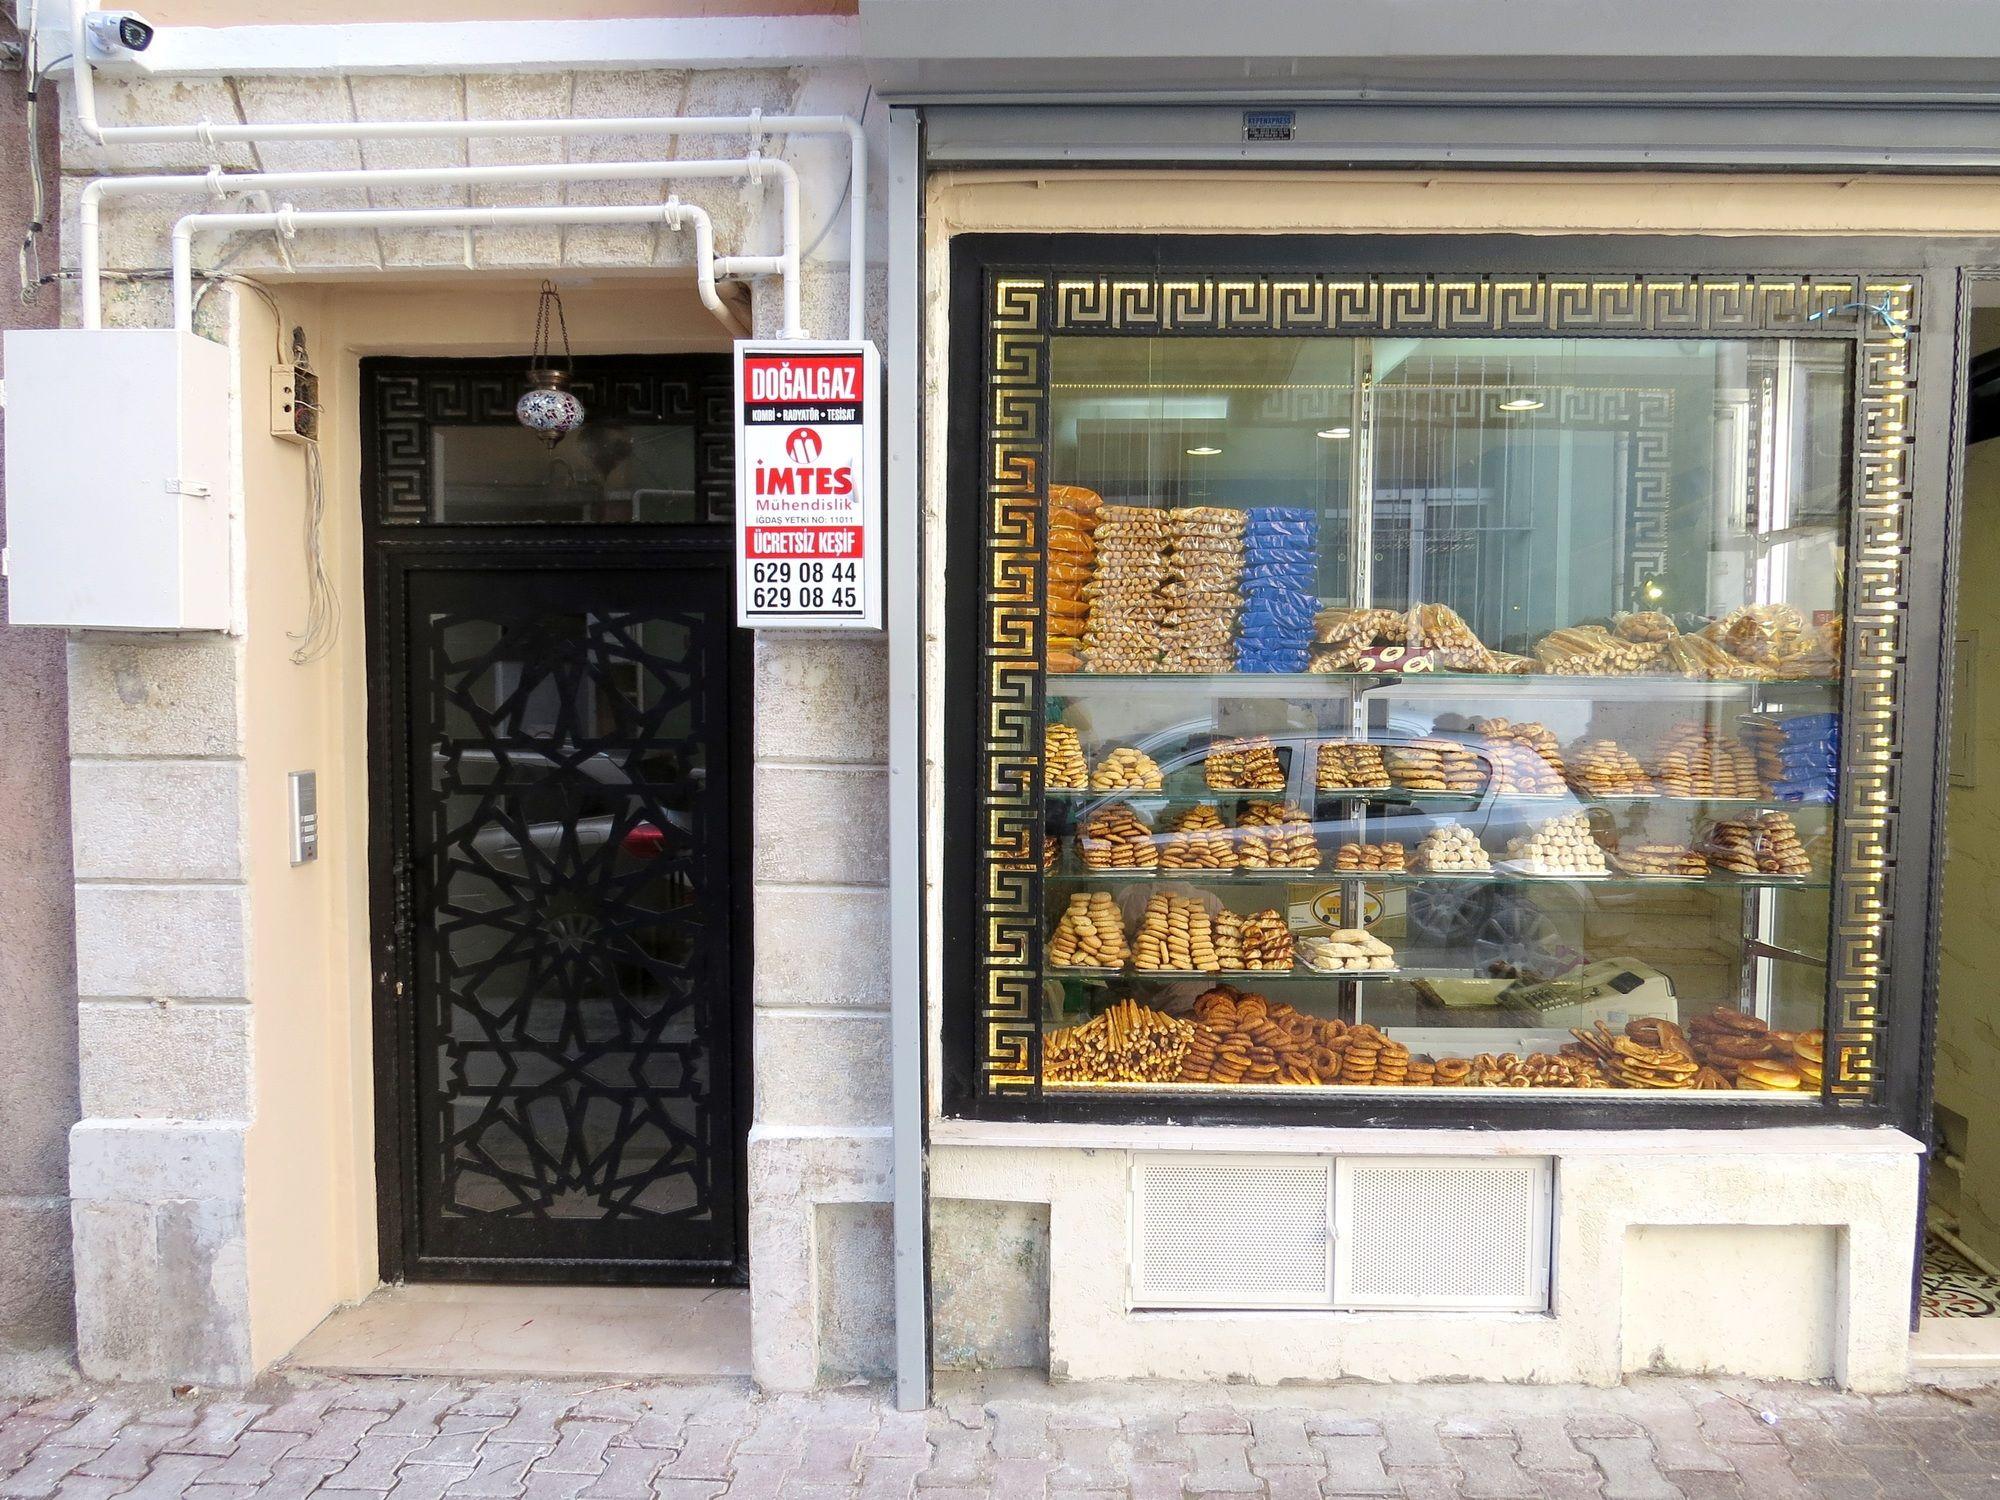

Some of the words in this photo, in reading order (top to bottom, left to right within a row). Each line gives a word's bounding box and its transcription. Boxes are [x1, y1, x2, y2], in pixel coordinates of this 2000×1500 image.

[752, 362, 856, 400] DOĞALGAZ
[752, 407, 776, 422] KOMBİ
[782, 407, 820, 422] RADYATÖR
[827, 407, 856, 421] TESİSAT
[755, 458, 853, 495] İMTES
[756, 499, 852, 511] Mühendislik
[830, 516, 853, 524] 11011
[753, 528, 816, 554] ÜCRETSİZ
[819, 528, 856, 557] KEŞİF
[754, 562, 791, 583] 629
[799, 562, 824, 583] 08
[831, 562, 857, 583] 44
[754, 587, 791, 608] 629
[799, 587, 824, 608] 08
[831, 587, 857, 608] 45
